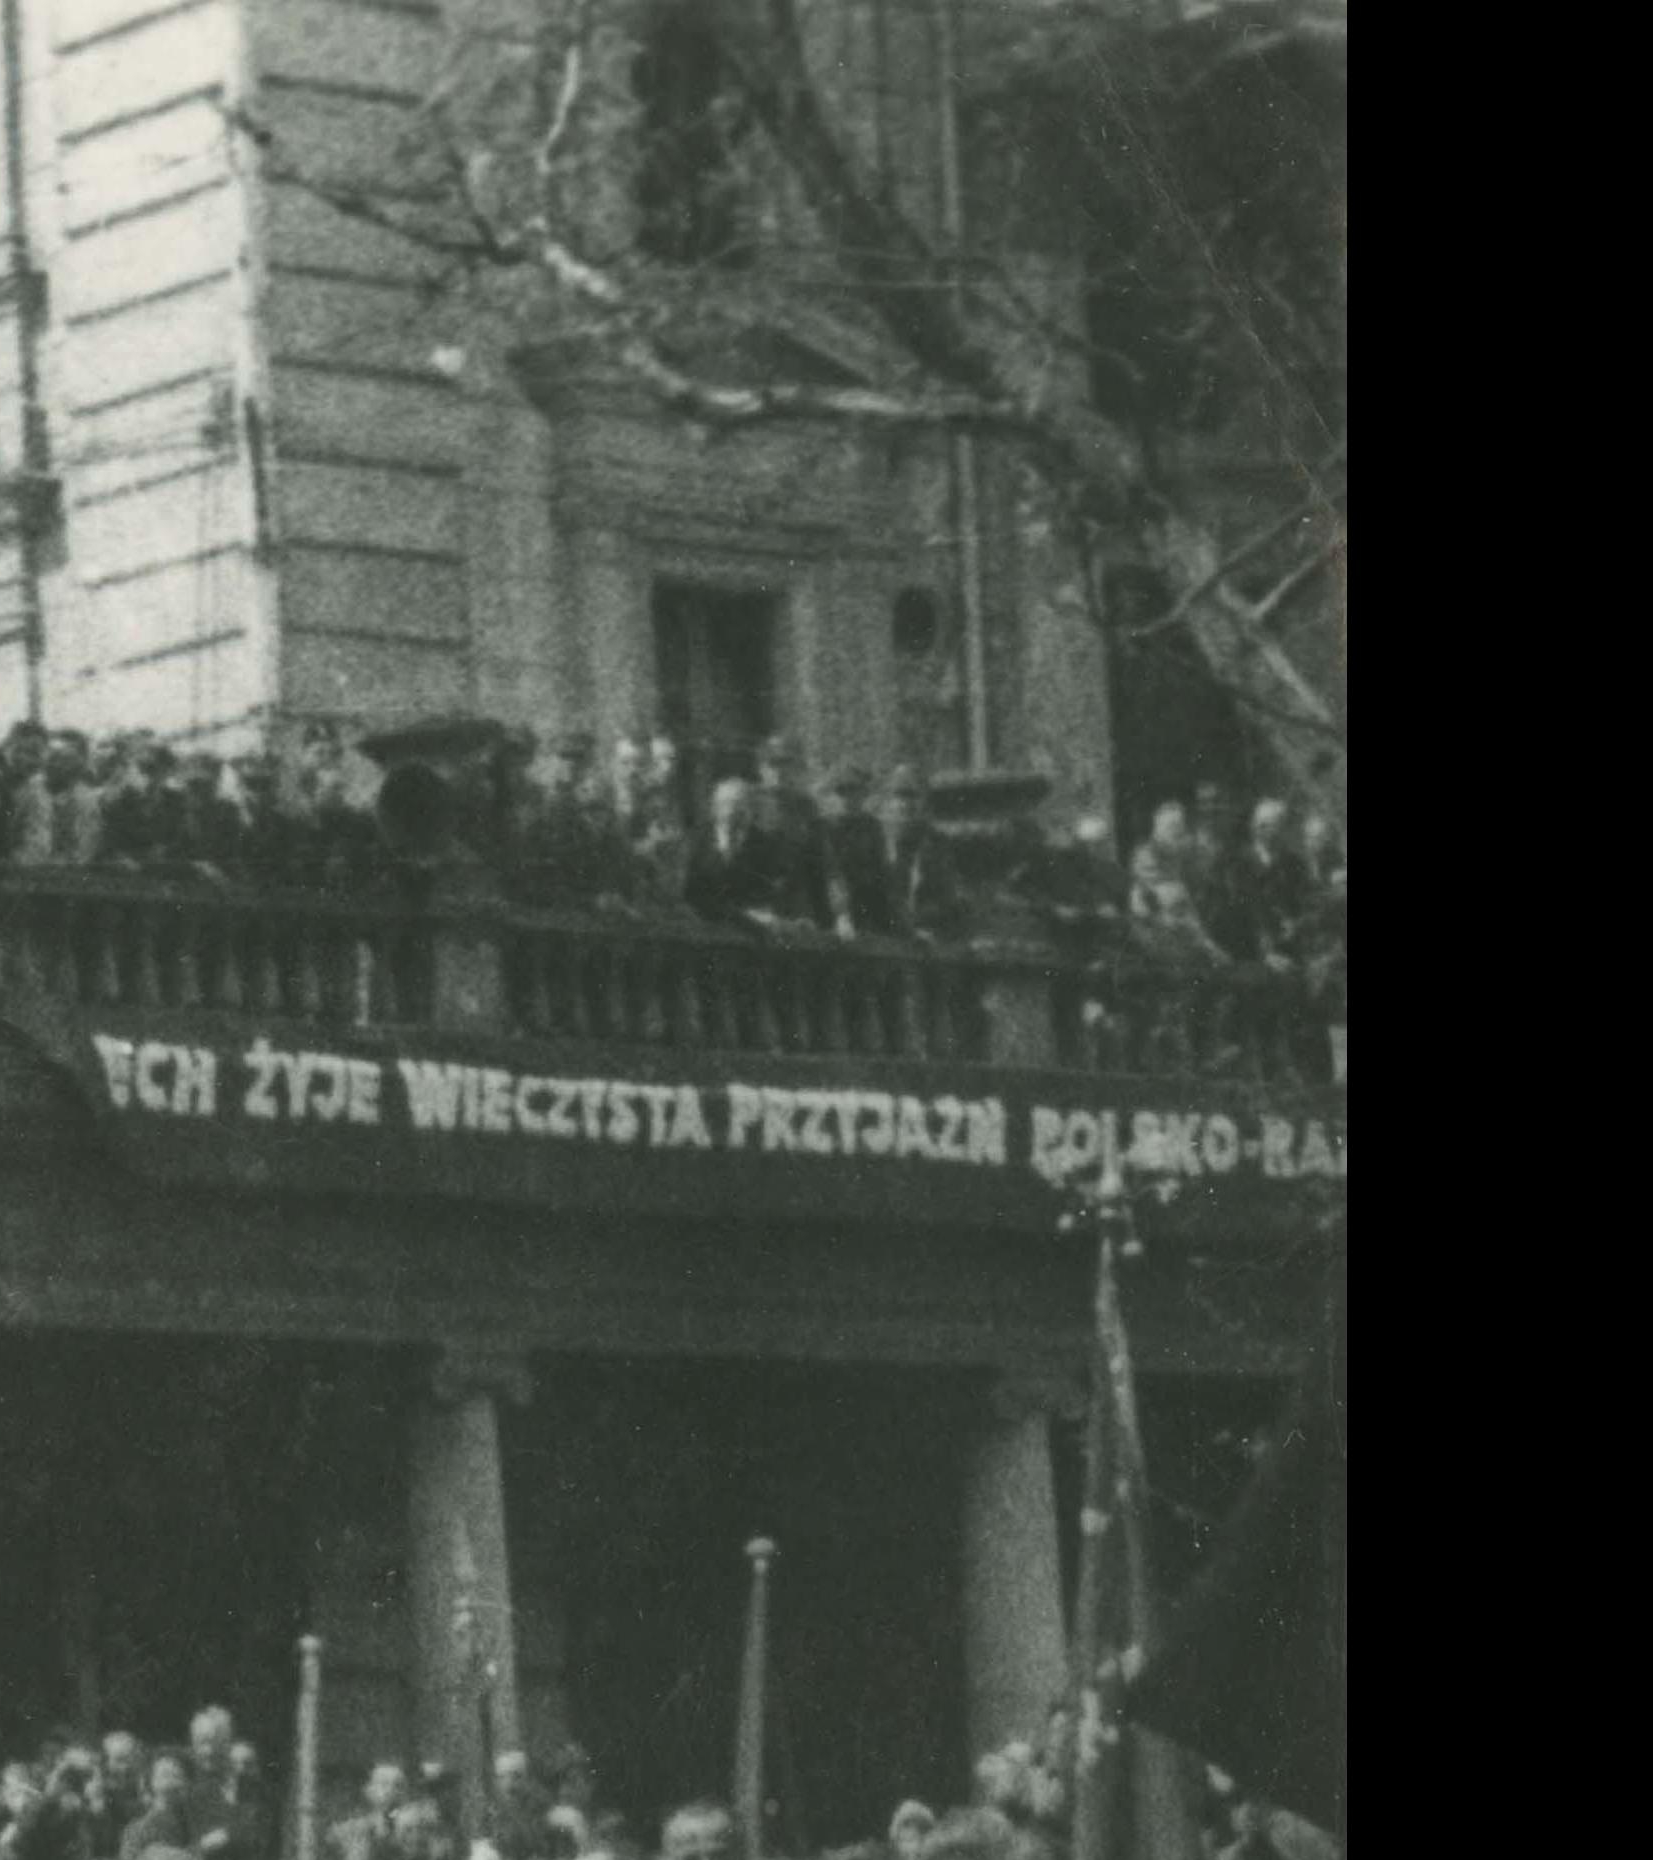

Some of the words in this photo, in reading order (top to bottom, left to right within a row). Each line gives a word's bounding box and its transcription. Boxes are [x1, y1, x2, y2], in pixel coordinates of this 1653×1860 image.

[243, 1036, 383, 1125] ŻYJE
[396, 1057, 713, 1149] WIECZYSTA
[1031, 1105, 1347, 1182] POLSKO-RA
